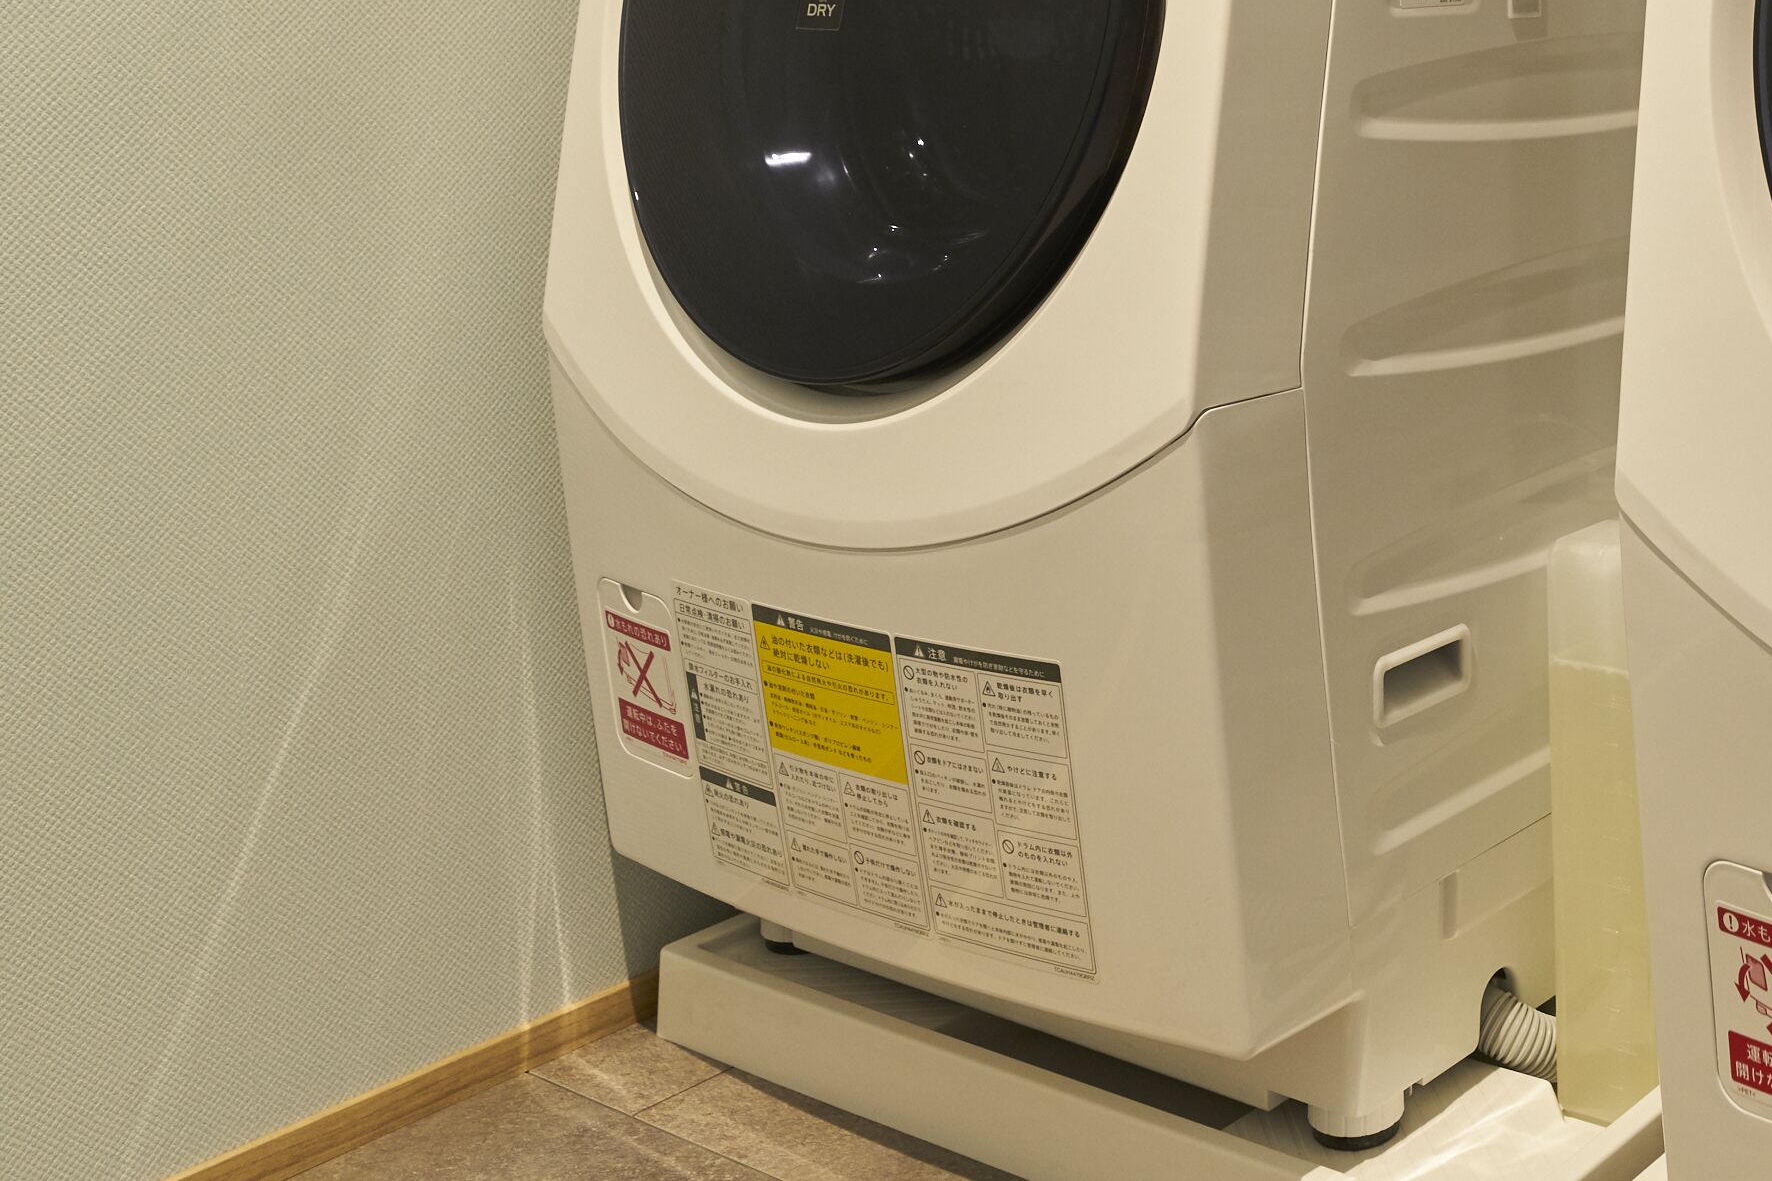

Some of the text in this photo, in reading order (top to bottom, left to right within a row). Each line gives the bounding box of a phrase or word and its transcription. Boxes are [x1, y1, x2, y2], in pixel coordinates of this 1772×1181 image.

[806, 3, 836, 17] DRY
[675, 585, 744, 613] オーナー様へのお願い
[787, 616, 804, 632] 警告
[615, 619, 668, 647] 水もれの恐れあり
[772, 647, 830, 670] 絶対に乾燥しない
[927, 647, 946, 662] 注意
[916, 676, 958, 691] 衣類を入れない
[997, 691, 1023, 703] 取り出す
[1006, 765, 1057, 781] やけどに注意する
